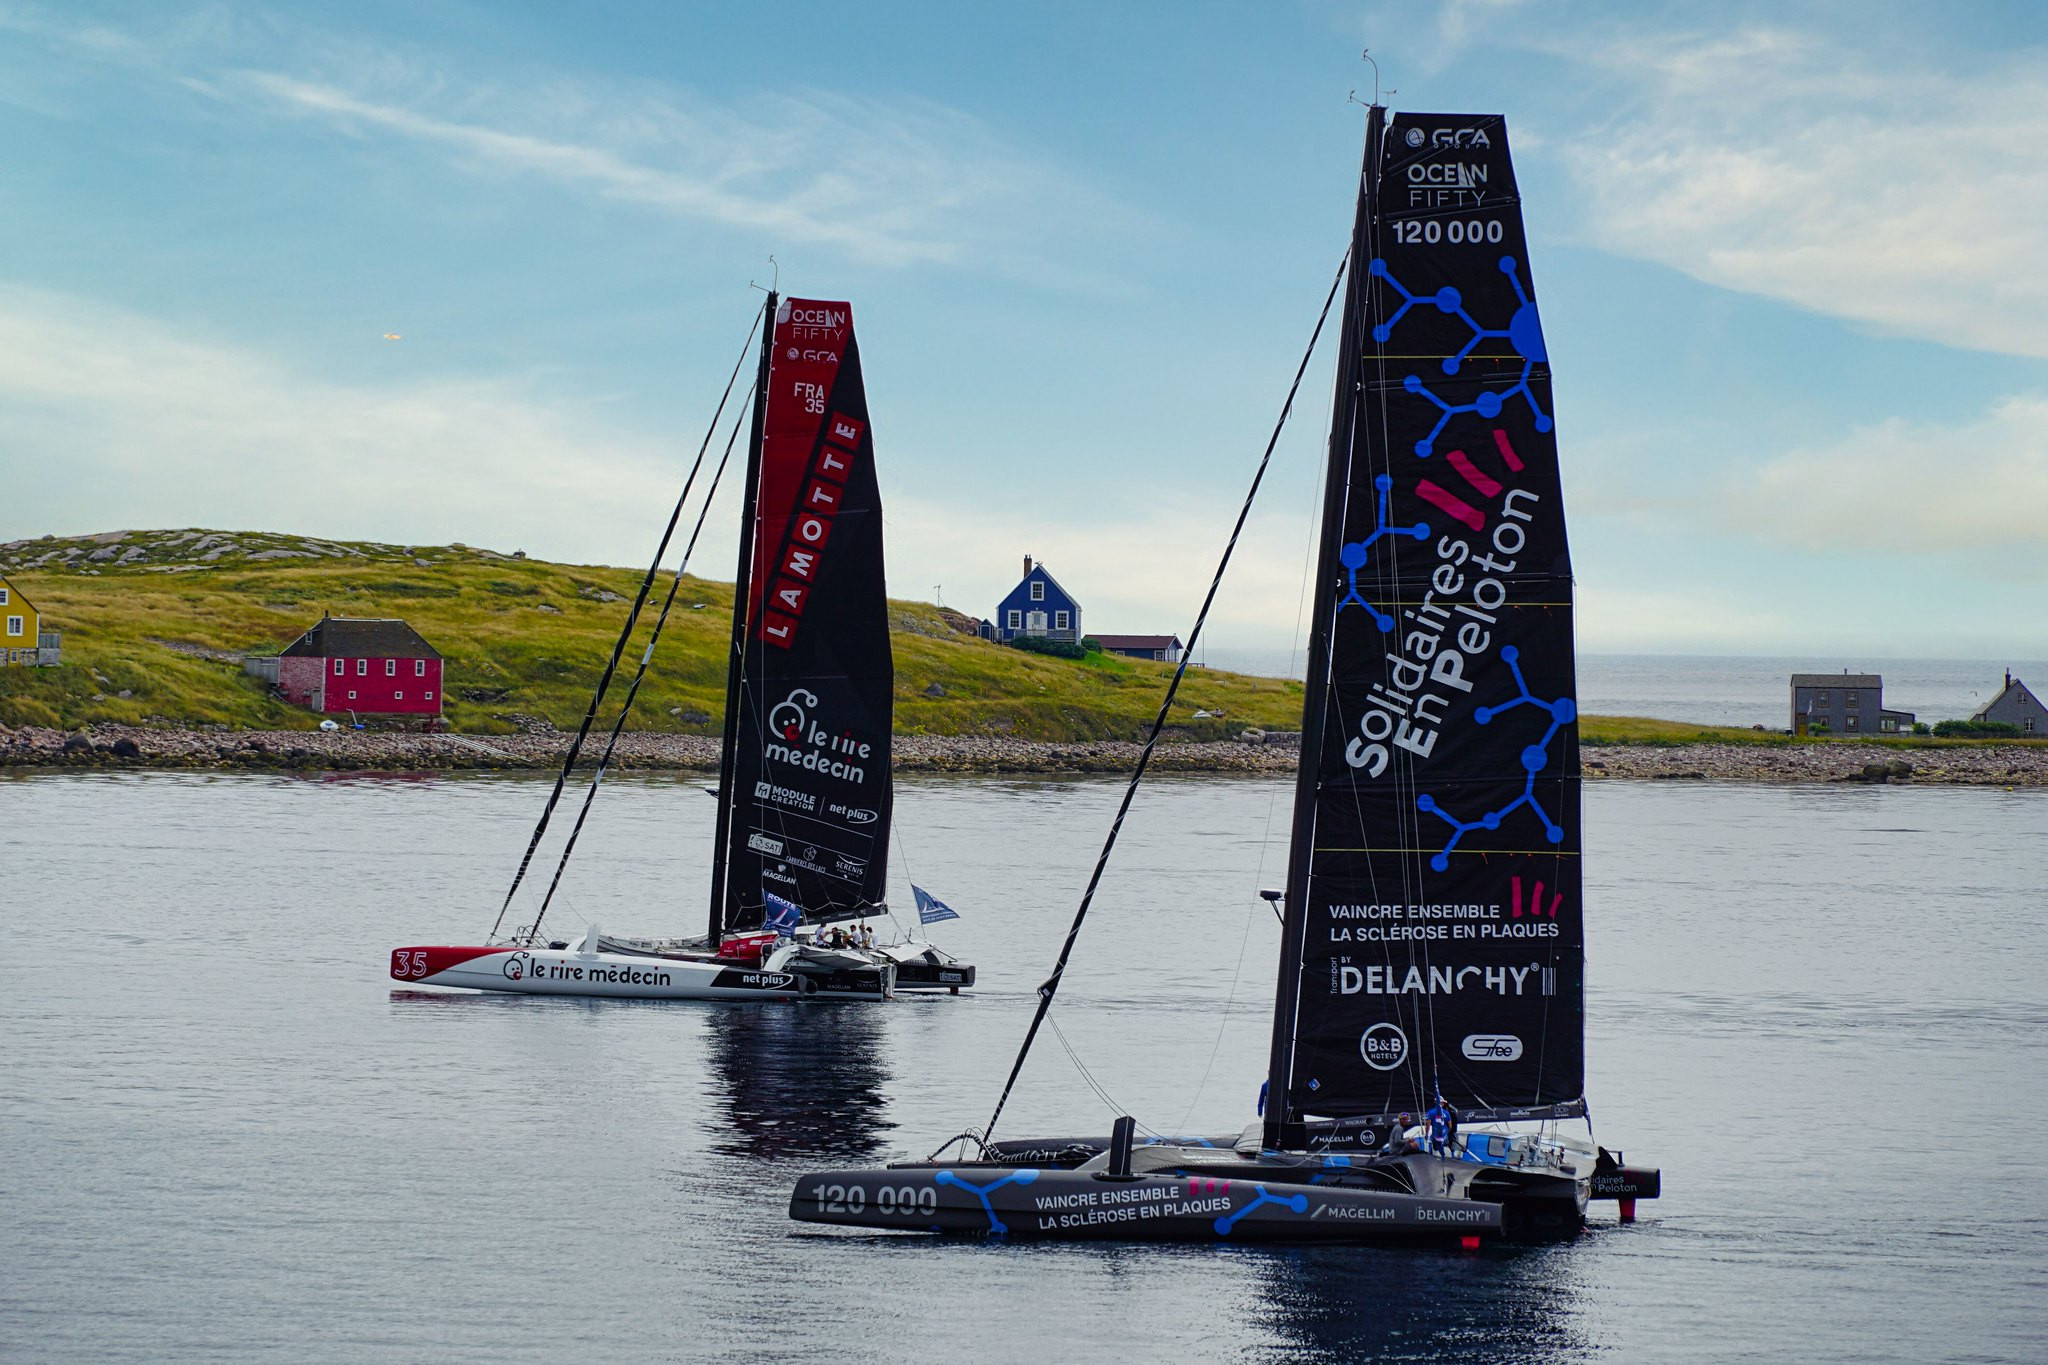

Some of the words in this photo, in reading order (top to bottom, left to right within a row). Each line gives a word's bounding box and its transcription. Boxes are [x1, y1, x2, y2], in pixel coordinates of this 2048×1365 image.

[1431, 128, 1491, 145] GCA
[1410, 190, 1487, 207] FIFTY
[1392, 220, 1442, 244] 120
[1447, 220, 1504, 244] 000
[792, 327, 844, 341] FIFTY
[794, 382, 825, 400] FRA
[804, 398, 825, 414] 35
[766, 422, 857, 639] LAMOTTE
[1392, 693, 1450, 759] En
[1429, 488, 1540, 693] Peloton
[1345, 535, 1470, 778] Solidaires
[807, 720, 828, 747] le
[832, 729, 871, 759] rire
[772, 785, 817, 805] MODULE
[829, 803, 847, 815] net
[846, 808, 869, 821] plus
[762, 870, 797, 885] MAGELLAN
[767, 892, 797, 910] ROUTE
[1329, 904, 1403, 919] VAINCRE
[1407, 904, 1500, 919] ENSEMBLE
[1330, 927, 1352, 942] LA
[1356, 923, 1449, 942] SCLÉROSE
[1453, 925, 1476, 939] EN
[1480, 923, 1560, 939] PLAQUES
[394, 951, 428, 977] 35
[530, 957, 545, 978] le
[550, 959, 584, 980] rire
[743, 973, 760, 984] net
[761, 973, 785, 987] plus
[1330, 956, 1339, 995] Transport
[1367, 1037, 1402, 1052] B&B
[1592, 1174, 1625, 1184] idaires
[1598, 1184, 1637, 1193] Peloton
[812, 1184, 866, 1214] 120
[877, 1186, 937, 1216] 000
[1035, 1193, 1098, 1210] VAINCRE
[1101, 1186, 1180, 1205] ENSEMBLE
[1038, 1216, 1058, 1230] LA
[1060, 1206, 1137, 1228] SCLÉROSE
[1140, 1205, 1160, 1220] EN
[1164, 1197, 1231, 1216] PLAQUES
[1328, 1208, 1396, 1220] MAGELLIM
